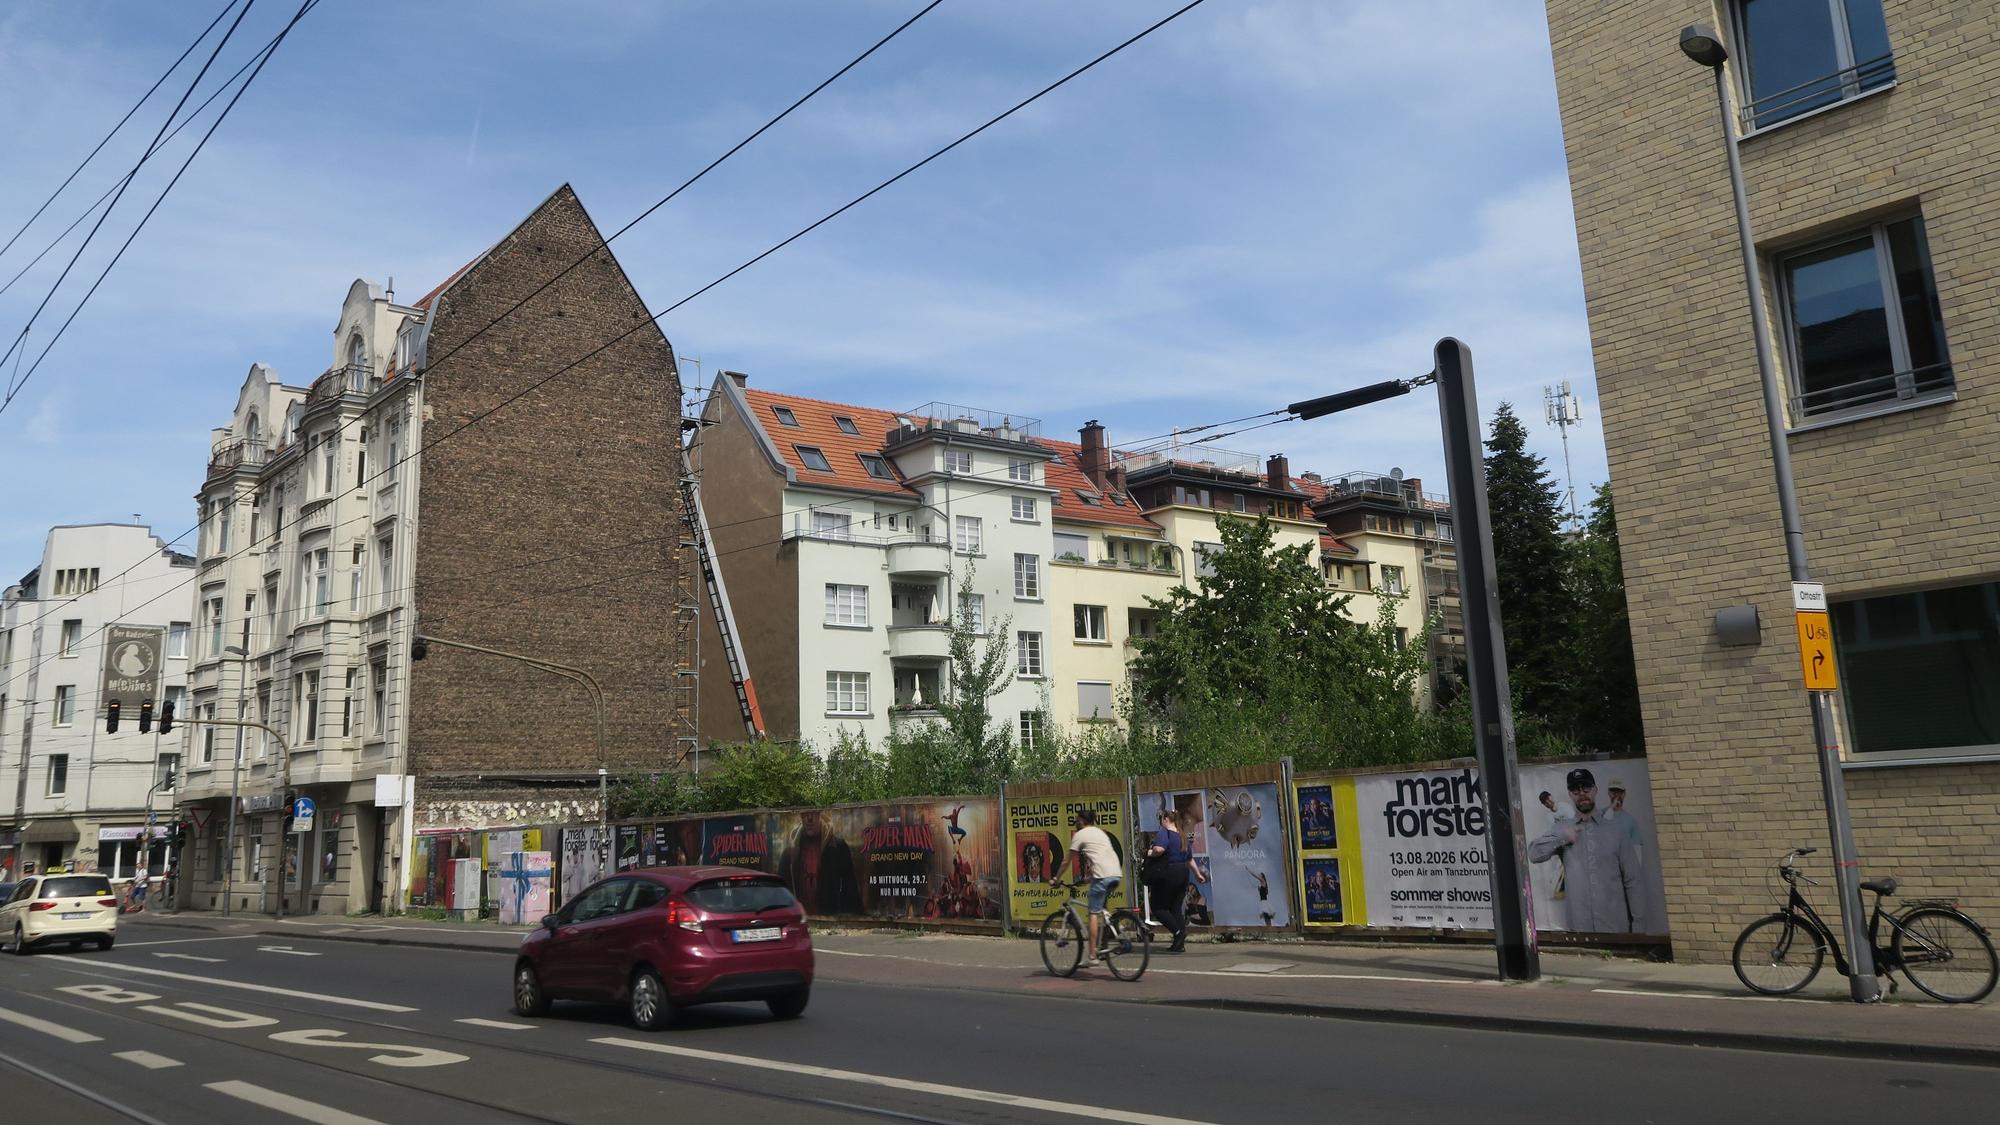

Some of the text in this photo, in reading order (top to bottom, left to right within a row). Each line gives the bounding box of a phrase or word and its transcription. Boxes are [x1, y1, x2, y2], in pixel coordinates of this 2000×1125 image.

[1805, 624, 1814, 640] U
[1396, 769, 1481, 806] mark
[1011, 803, 1058, 817] ROLLING
[1066, 801, 1117, 814] ROLLING
[1012, 816, 1058, 829] STONES
[1067, 814, 1117, 826] SNES
[1383, 801, 1485, 837] forste
[591, 828, 610, 839] mk
[871, 852, 923, 861] BRAND NEW DAY
[1224, 849, 1265, 859] PANDORA
[1389, 847, 1488, 864] 13.08.2026 KÖL
[719, 857, 737, 865] BRAND
[750, 856, 760, 864] DAY
[1391, 868, 1414, 878] Open
[1416, 868, 1428, 876] Air
[1445, 867, 1488, 876] Tanzbrunn
[869, 875, 928, 884] AB MITTWOCH, 29.7.
[880, 887, 917, 896] NUR IM KINO
[1013, 889, 1025, 897] DAS
[1042, 889, 1064, 897] ALBUM
[1390, 887, 1490, 901] sommer shows
[54, 984, 471, 1067] BUS
